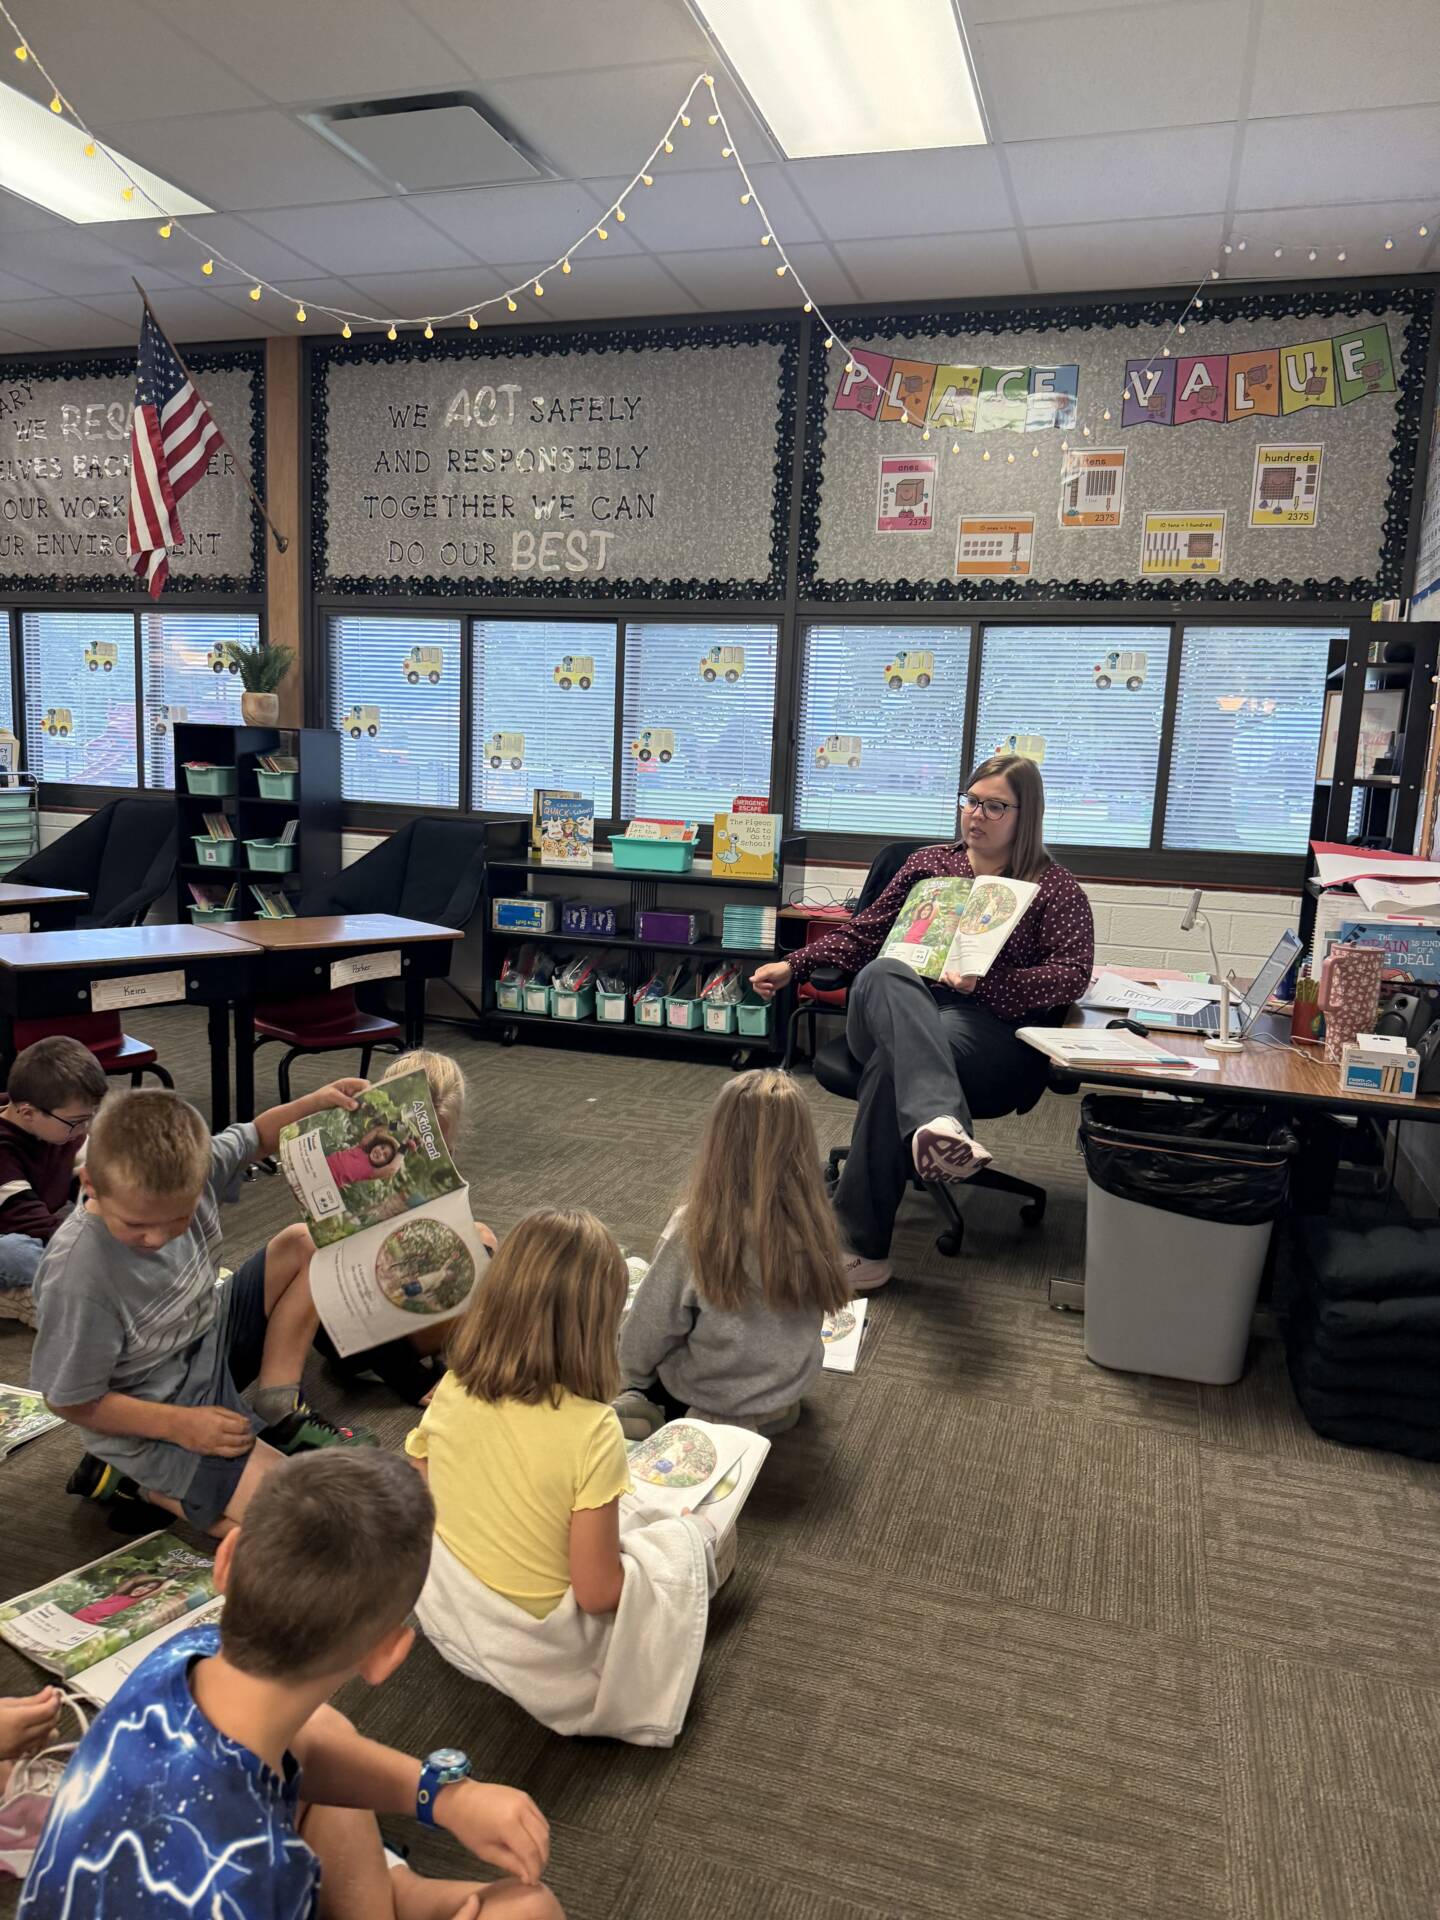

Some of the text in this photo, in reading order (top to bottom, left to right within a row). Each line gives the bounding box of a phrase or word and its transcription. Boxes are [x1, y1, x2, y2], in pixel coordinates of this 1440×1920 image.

[843, 339, 1366, 422] PLACE VALUE
[388, 384, 642, 428] WE ACT SAFELY
[13, 419, 47, 441] WE
[374, 445, 649, 474] AND RESPONSIBLY
[1265, 452, 1315, 462] hundreds
[3, 496, 126, 520] OUR WORK
[364, 493, 655, 520] TOGETHER WE CAN
[1287, 513, 1310, 521] 2375
[1095, 514, 1115, 522] 2375
[388, 530, 615, 571] DO OUR BEST
[733, 799, 768, 807] EMERGENCY
[746, 819, 772, 827] Pigeon
[1377, 933, 1393, 941] THE
[1396, 953, 1434, 966] DEAL
[413, 1101, 440, 1160] A Kid Can!
